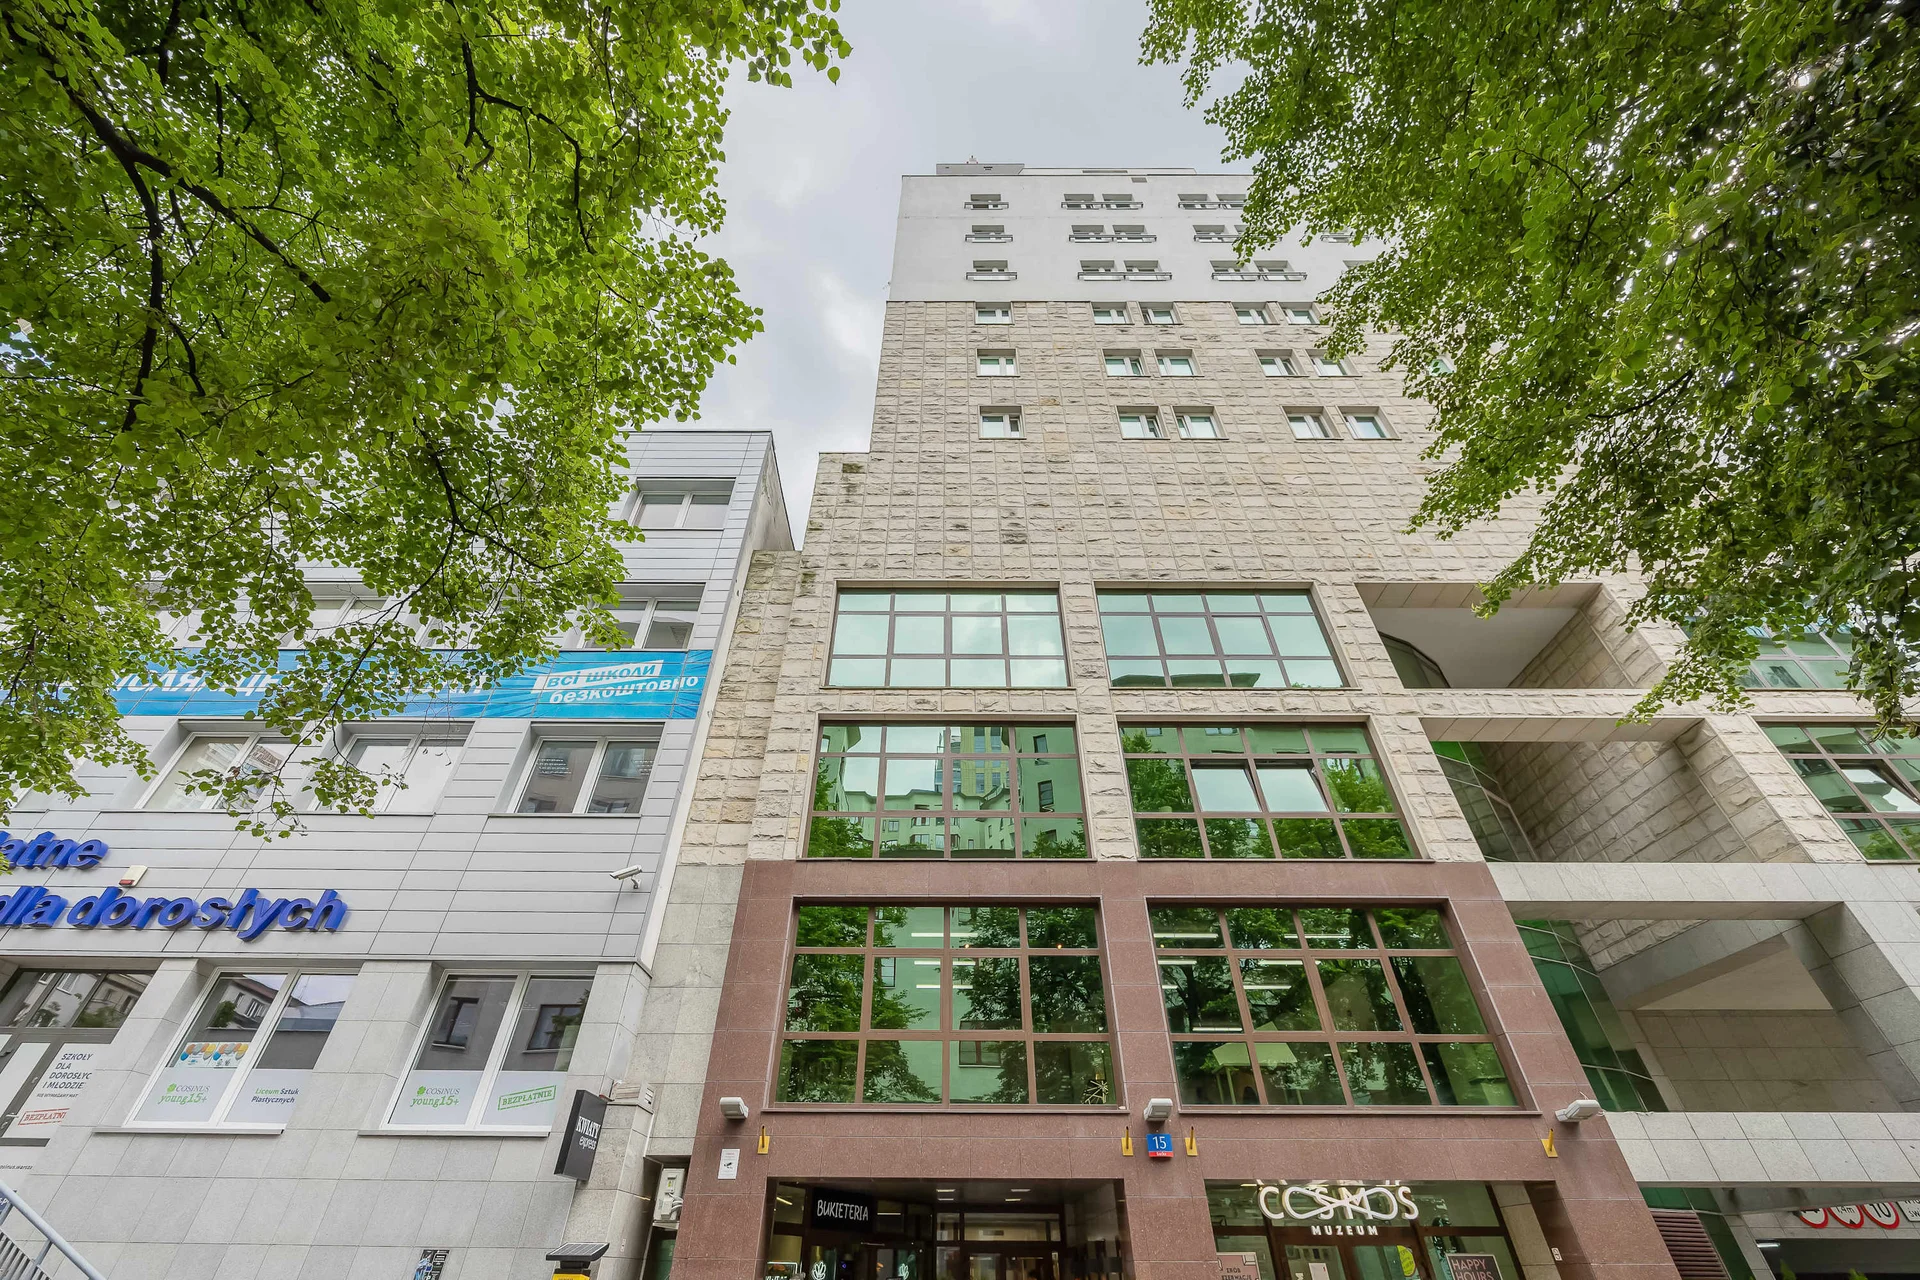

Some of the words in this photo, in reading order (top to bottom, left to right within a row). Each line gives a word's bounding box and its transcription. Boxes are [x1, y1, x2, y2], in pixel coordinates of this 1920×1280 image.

[549, 676, 699, 705] безкоштовно
[66, 887, 348, 942] dorosłych
[61, 1053, 94, 1061] SZKOŁY
[55, 1062, 72, 1070] DLA
[47, 1081, 86, 1089] MŁODZIE
[175, 1084, 211, 1093] COSINUS
[255, 1087, 280, 1095] Liceum
[280, 1087, 300, 1095] Sztuk
[425, 1087, 461, 1095] COSINUS
[251, 1095, 296, 1104] Plastycznych
[502, 1089, 553, 1106] BEZPŁATNIE
[575, 1115, 600, 1139] KWIATY
[578, 1135, 597, 1150] express
[1152, 1136, 1167, 1150] 15
[1258, 1186, 1419, 1220] COSMOS
[816, 1199, 869, 1222] BUKIETERIA
[1311, 1225, 1379, 1236] MUZEUM
[1451, 1259, 1487, 1271] HAPPY
[1455, 1271, 1494, 1280] HOURS
